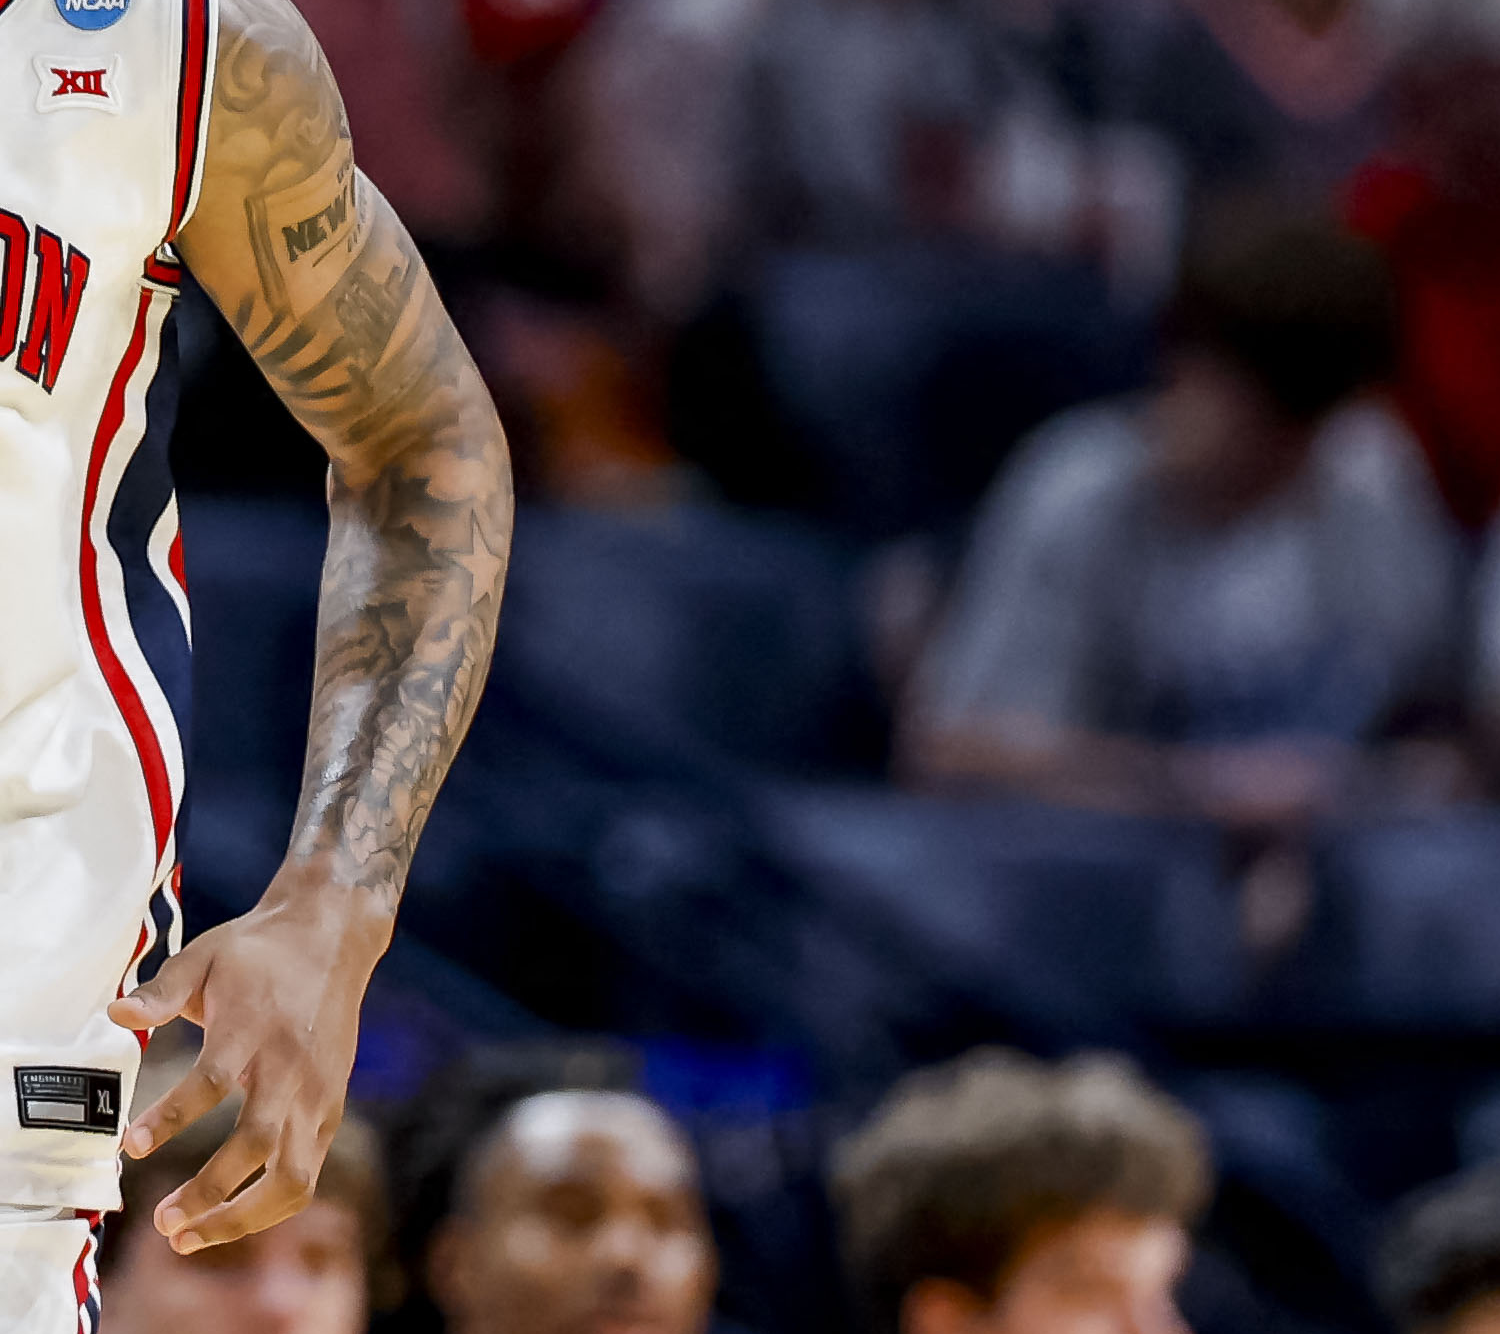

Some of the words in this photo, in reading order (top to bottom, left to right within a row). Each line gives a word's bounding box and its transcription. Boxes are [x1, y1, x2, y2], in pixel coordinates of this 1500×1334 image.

[50, 67, 110, 99] XII
[281, 185, 348, 263] NEW
[96, 1088, 115, 1116] XL
